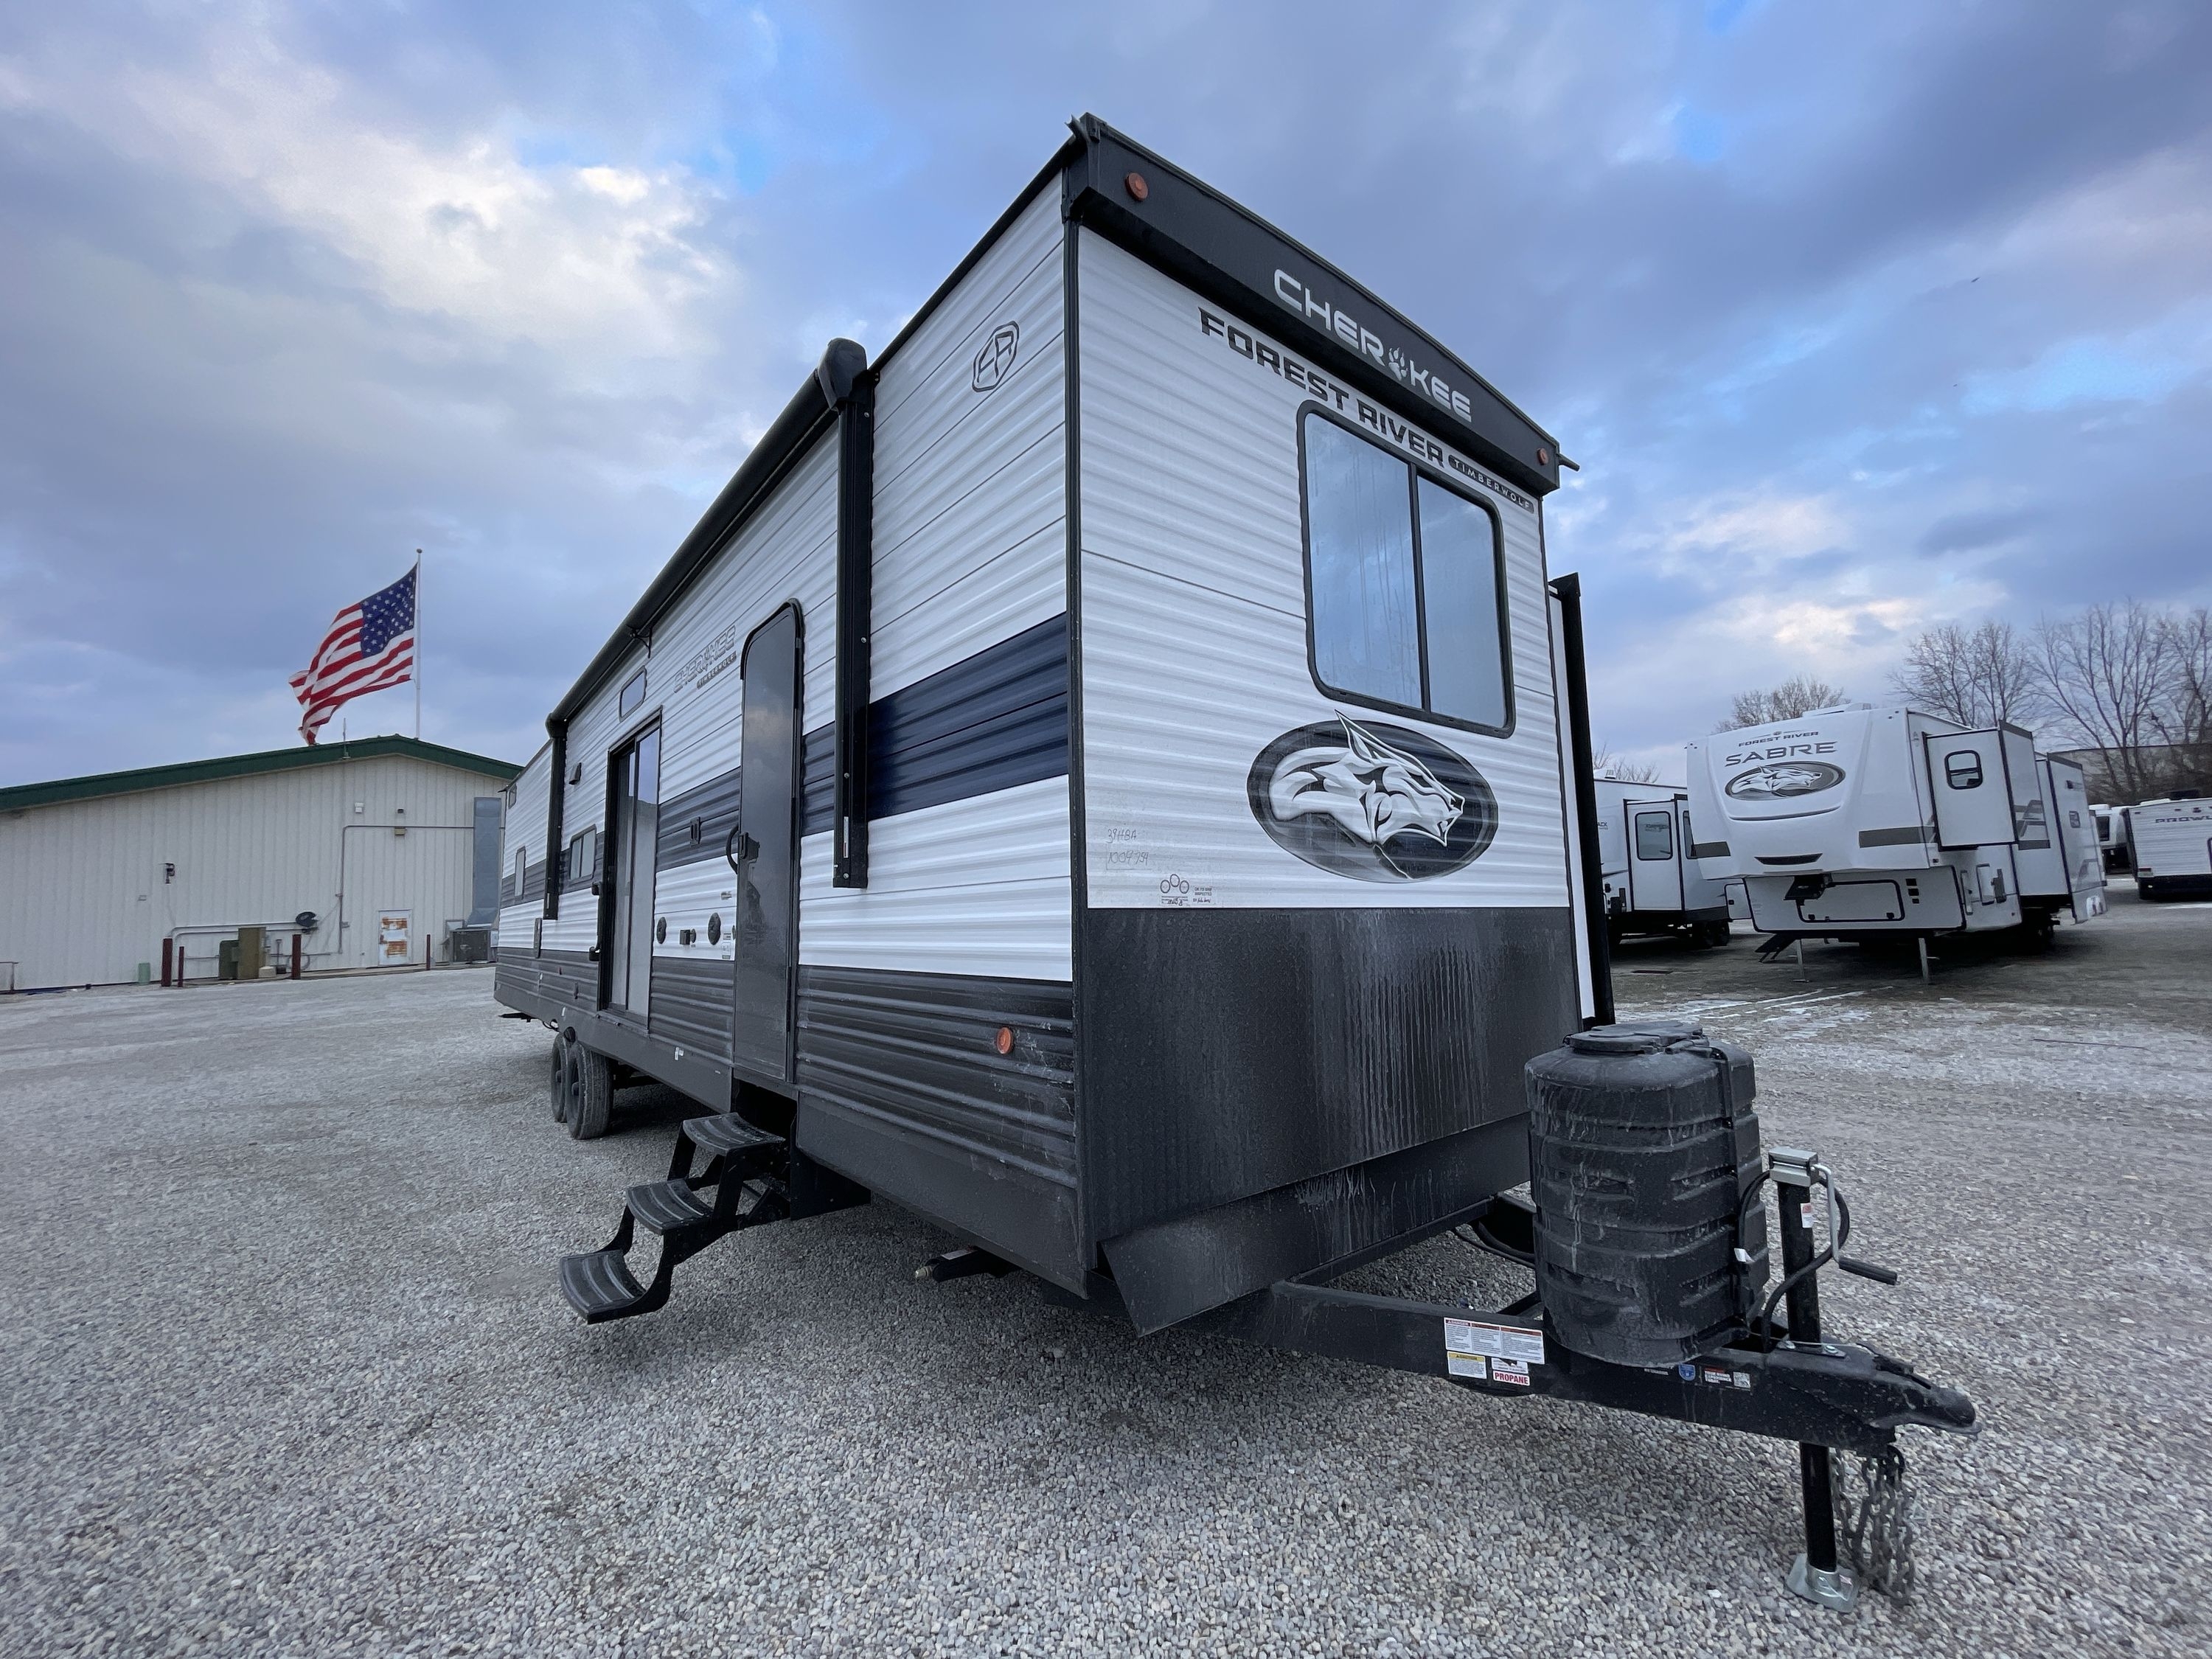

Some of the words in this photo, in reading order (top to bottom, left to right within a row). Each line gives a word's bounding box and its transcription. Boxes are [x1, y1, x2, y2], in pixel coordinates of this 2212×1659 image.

[1197, 306, 1349, 411] FOREST
[1356, 398, 1445, 468] RIVER
[1453, 459, 1530, 509] TIMBERWOLF
[1738, 737, 1781, 747] FOREST
[1783, 731, 1819, 740] RIVER
[1724, 741, 1838, 767] SABRE
[1495, 1371, 1529, 1385] PROPANE
